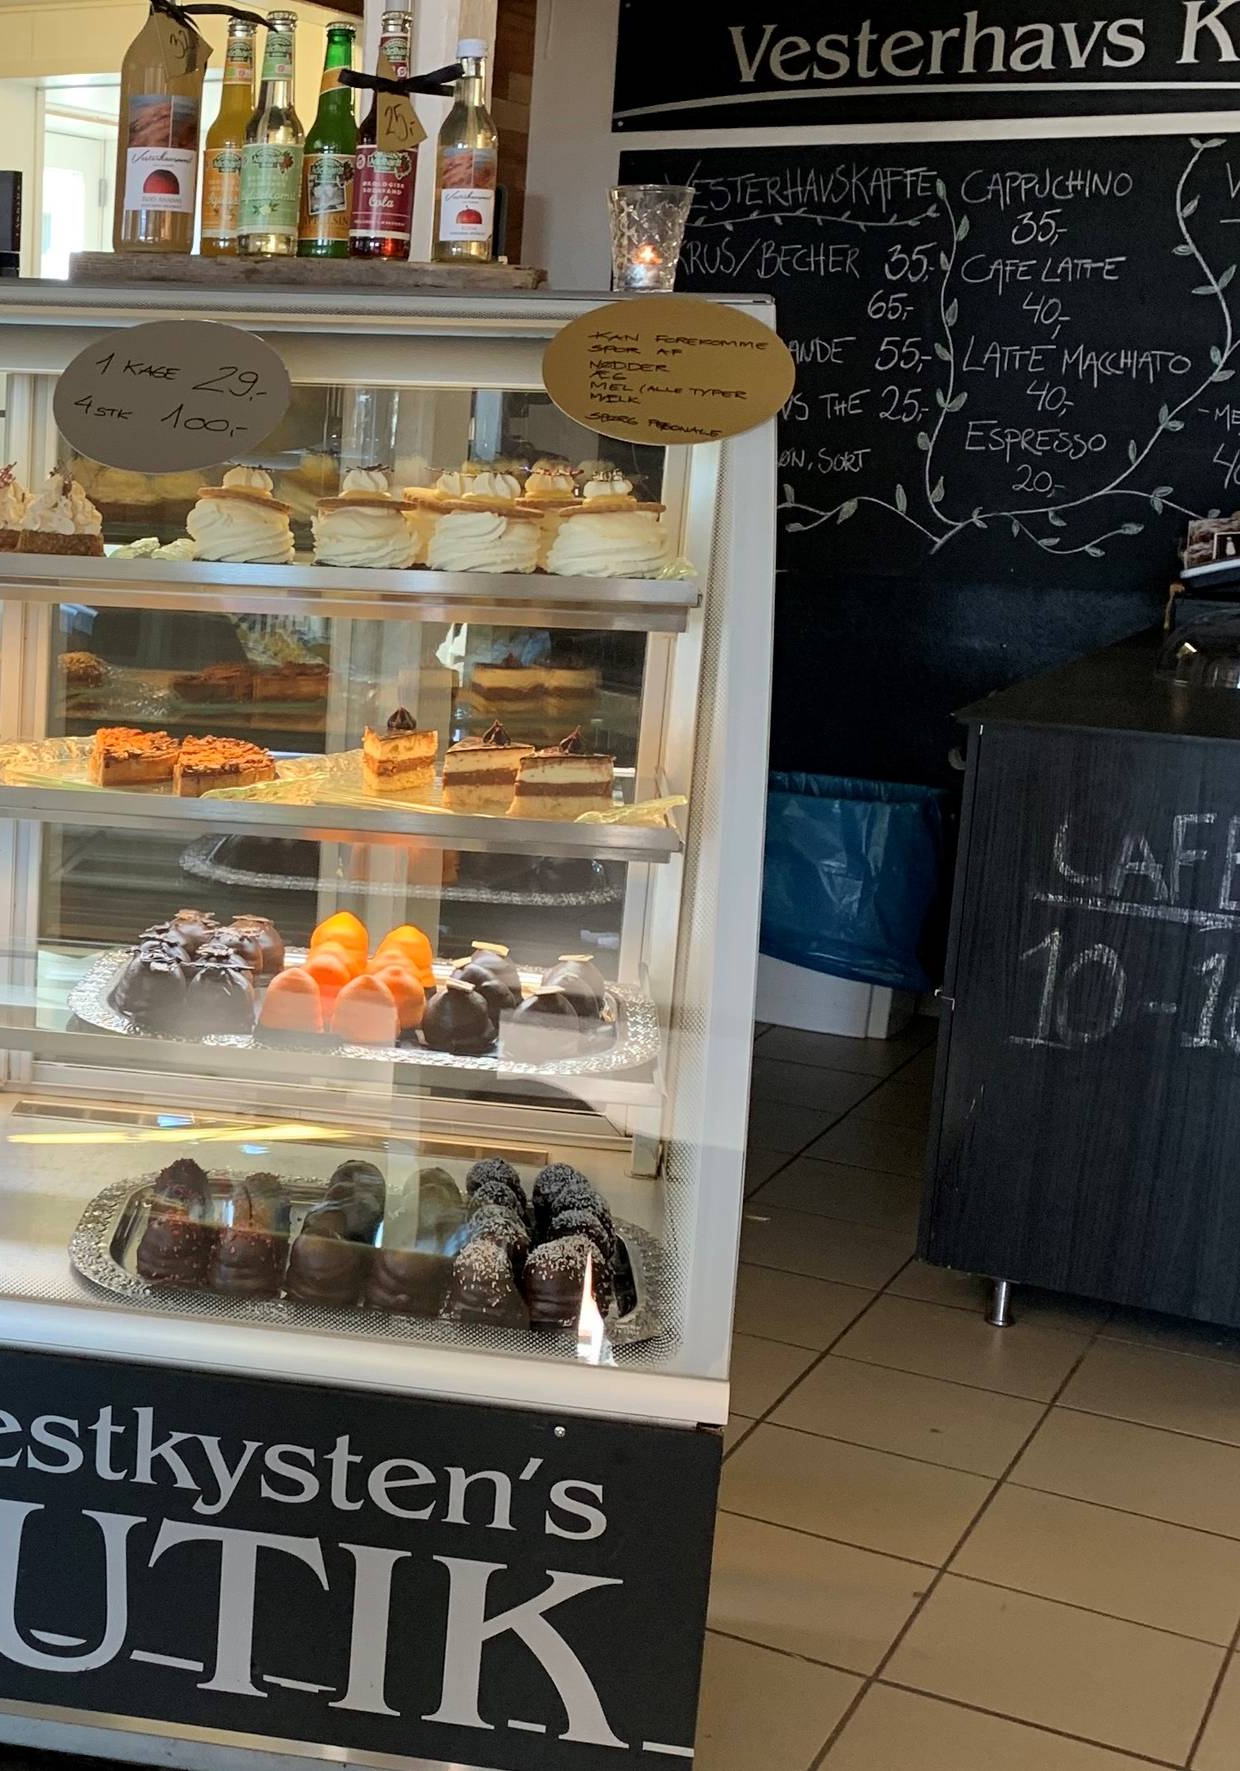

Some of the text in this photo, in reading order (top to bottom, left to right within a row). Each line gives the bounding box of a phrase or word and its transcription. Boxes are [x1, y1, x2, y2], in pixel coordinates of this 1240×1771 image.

[728, 0, 1240, 83] Vesterhavs K
[961, 168, 1133, 211] CAPPUCHINO
[961, 254, 1127, 296] CAFE LATTE
[588, 331, 769, 350] KAN FOREKOMME
[95, 352, 116, 375] 1
[122, 359, 181, 381] KAGE
[962, 335, 1192, 389] LATTE MACCHIATO
[73, 394, 93, 415] 4
[93, 406, 134, 420] STK
[589, 380, 634, 392] MEL
[688, 387, 749, 400] TYPER
[818, 388, 872, 420] THE
[964, 420, 1107, 463] ESPRESSO
